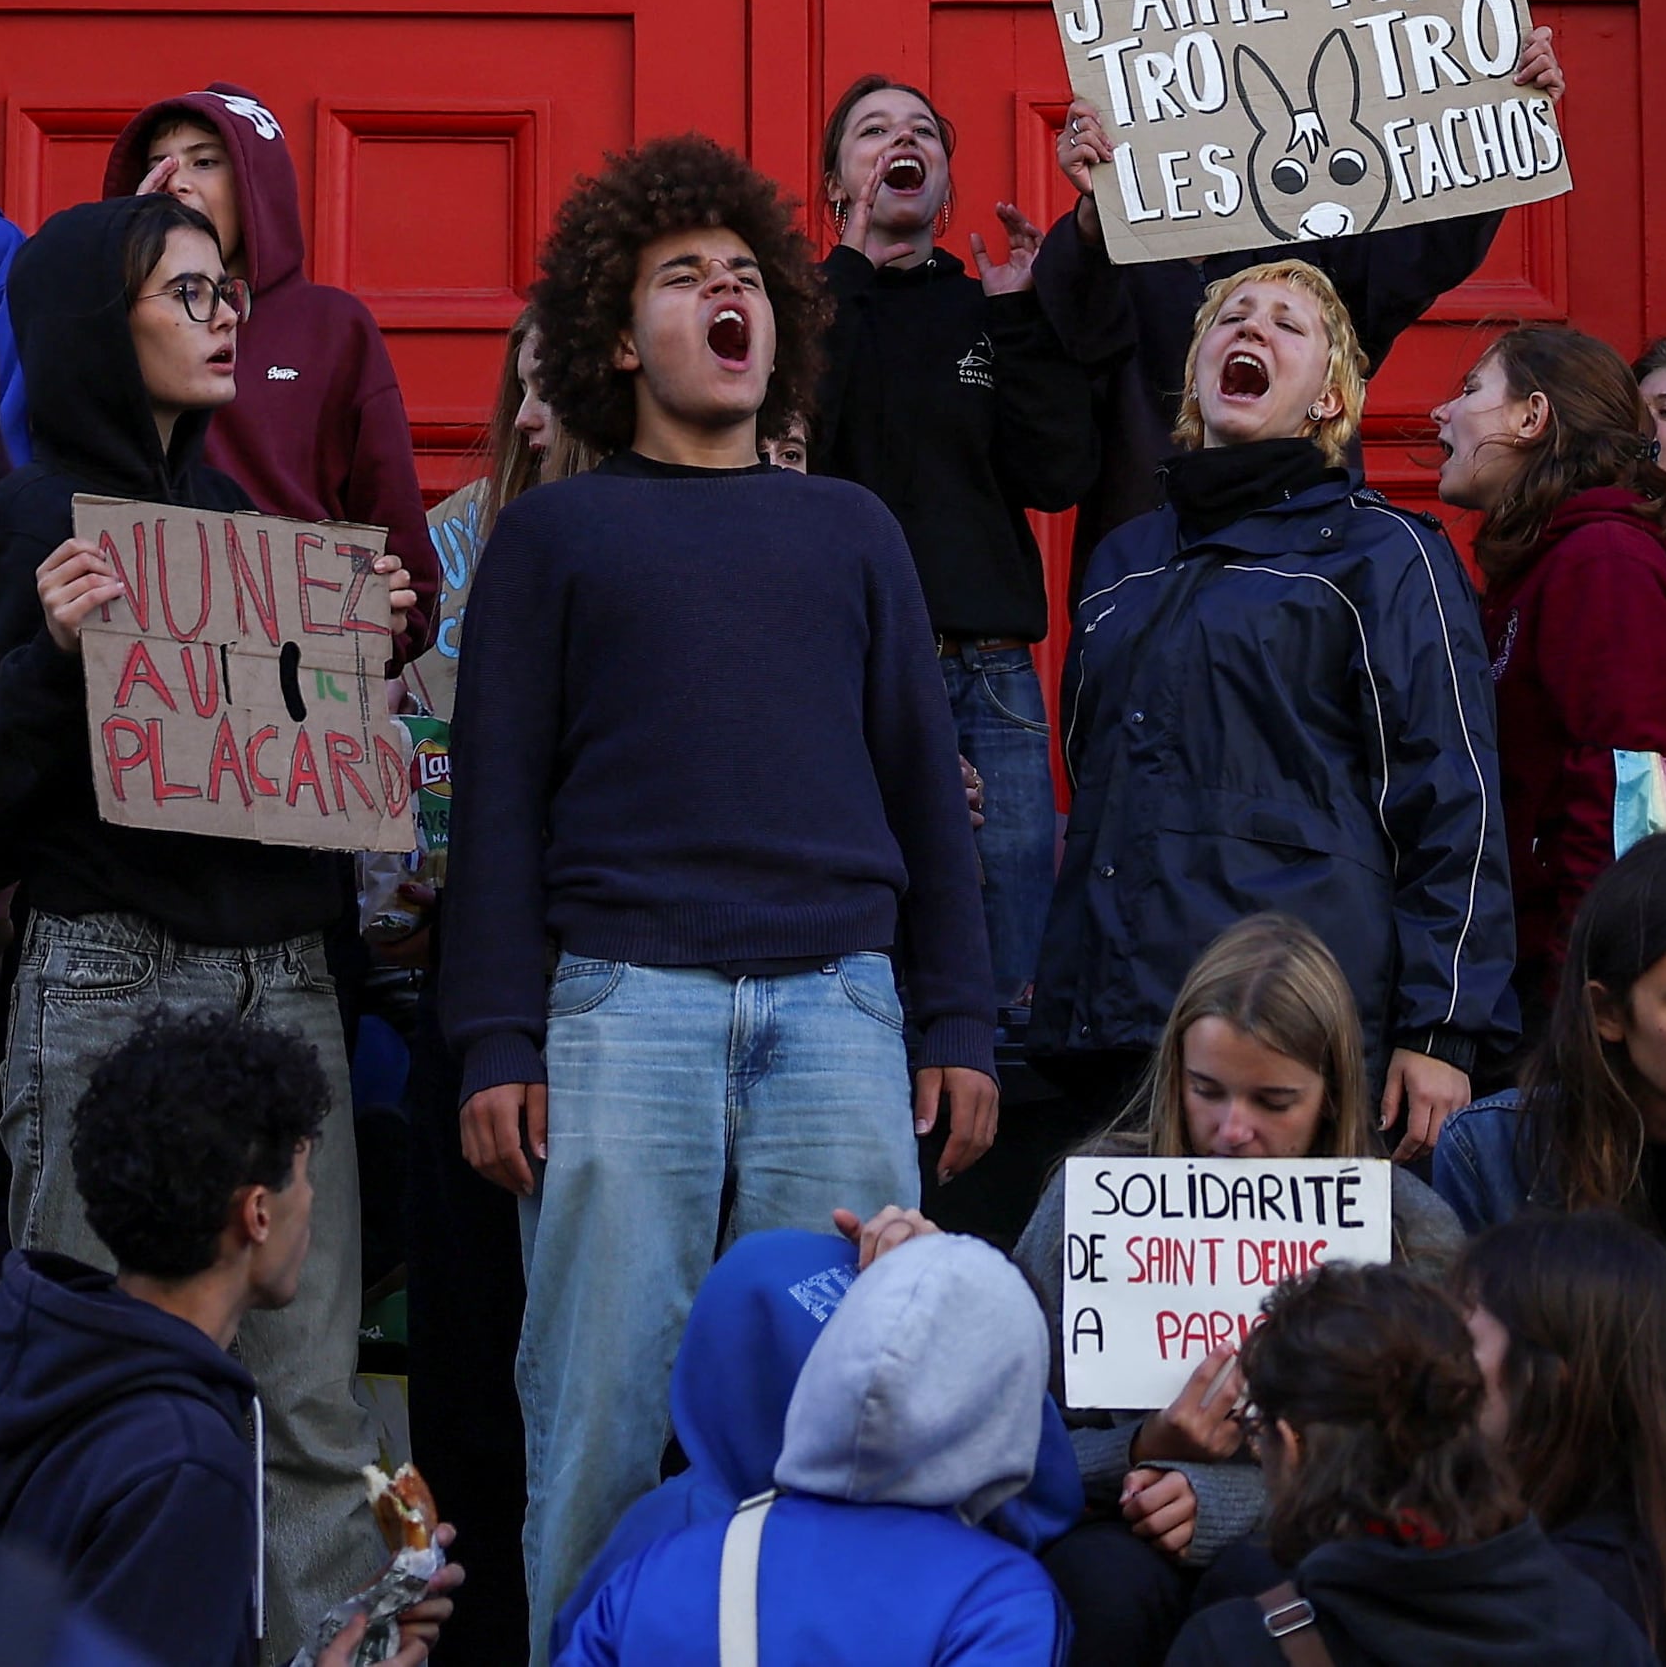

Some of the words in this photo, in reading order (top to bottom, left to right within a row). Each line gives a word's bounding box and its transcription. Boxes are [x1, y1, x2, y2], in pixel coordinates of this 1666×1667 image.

[1088, 31, 1229, 128] TRO
[1112, 140, 1243, 225] LES
[1383, 96, 1564, 204] FACHOS
[99, 517, 389, 647] NUNEZ
[114, 640, 218, 719] AU
[101, 711, 411, 820] PLACARD
[1068, 1234, 1108, 1282] DE
[1126, 1236, 1224, 1286] SAINT
[1073, 1307, 1103, 1354] A
